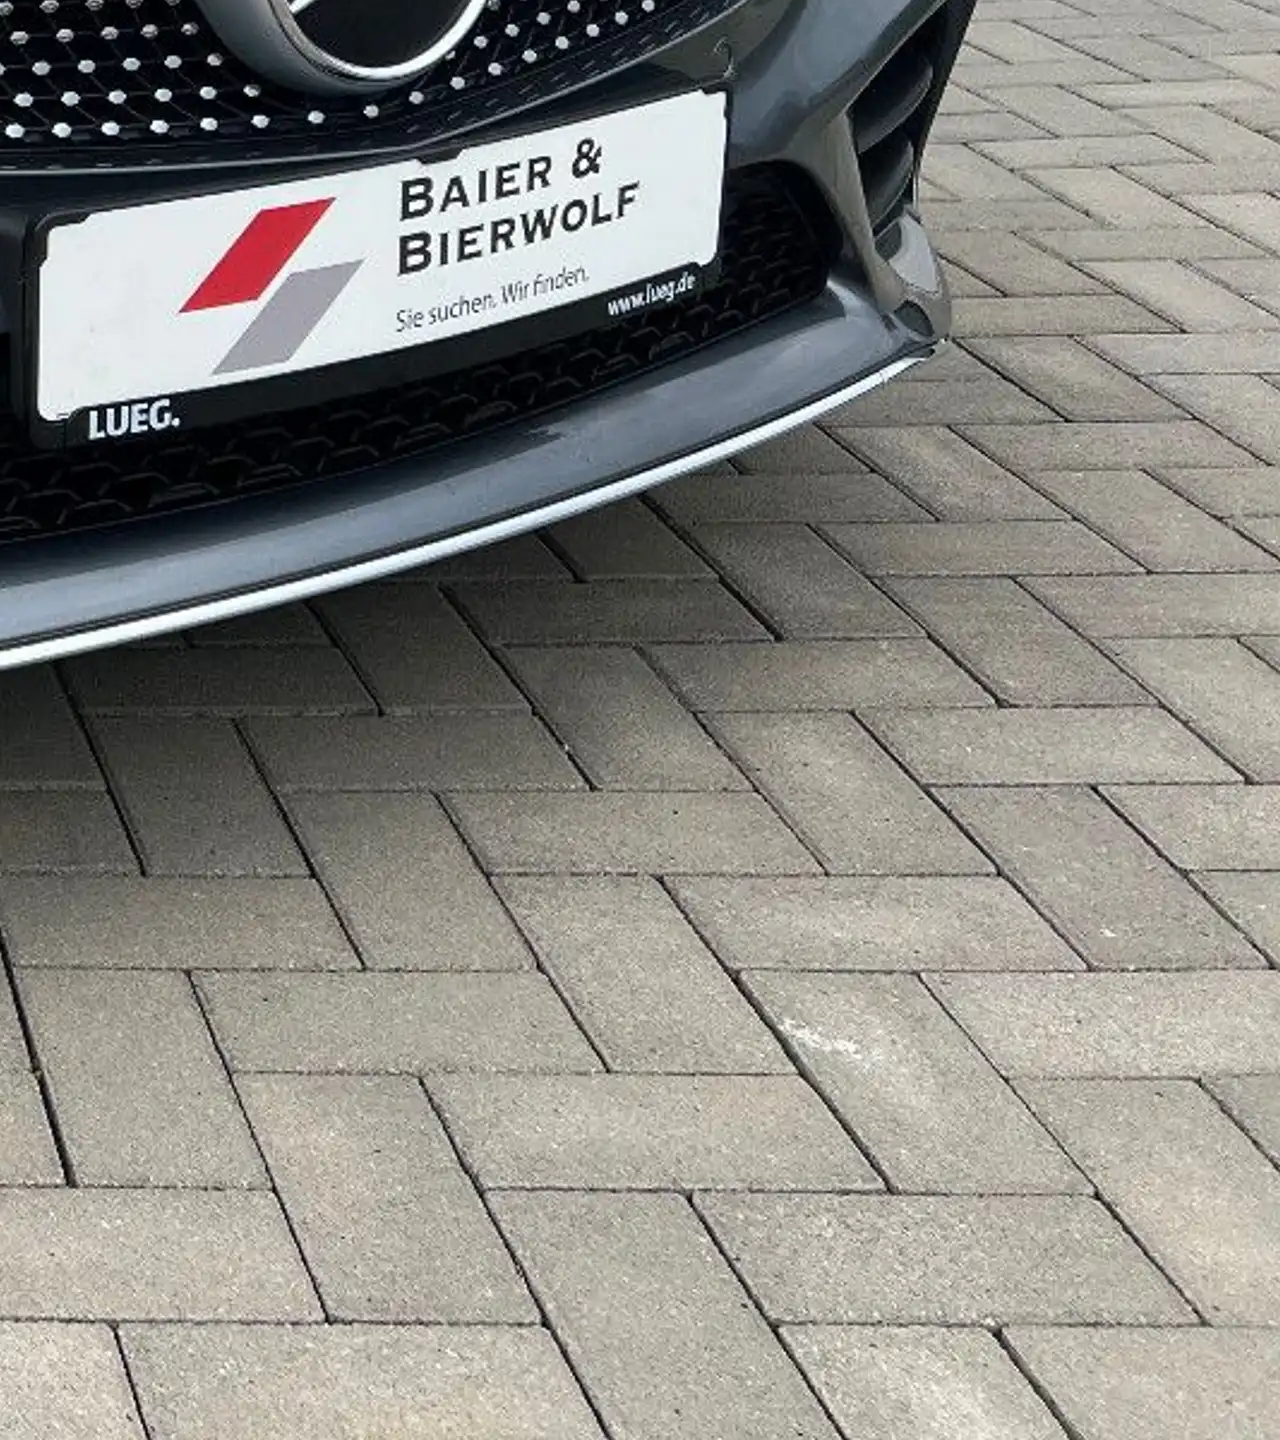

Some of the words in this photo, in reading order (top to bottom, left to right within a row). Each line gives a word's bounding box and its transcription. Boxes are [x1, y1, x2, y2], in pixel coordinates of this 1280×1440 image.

[400, 156, 553, 222] BAIER
[571, 137, 603, 179] &
[397, 180, 640, 277] BIERWOLF
[396, 310, 425, 332] Sie
[428, 293, 498, 326] suchen.
[501, 281, 531, 304] Wir
[532, 265, 591, 297] finden.
[607, 271, 696, 316] www.lueg.de
